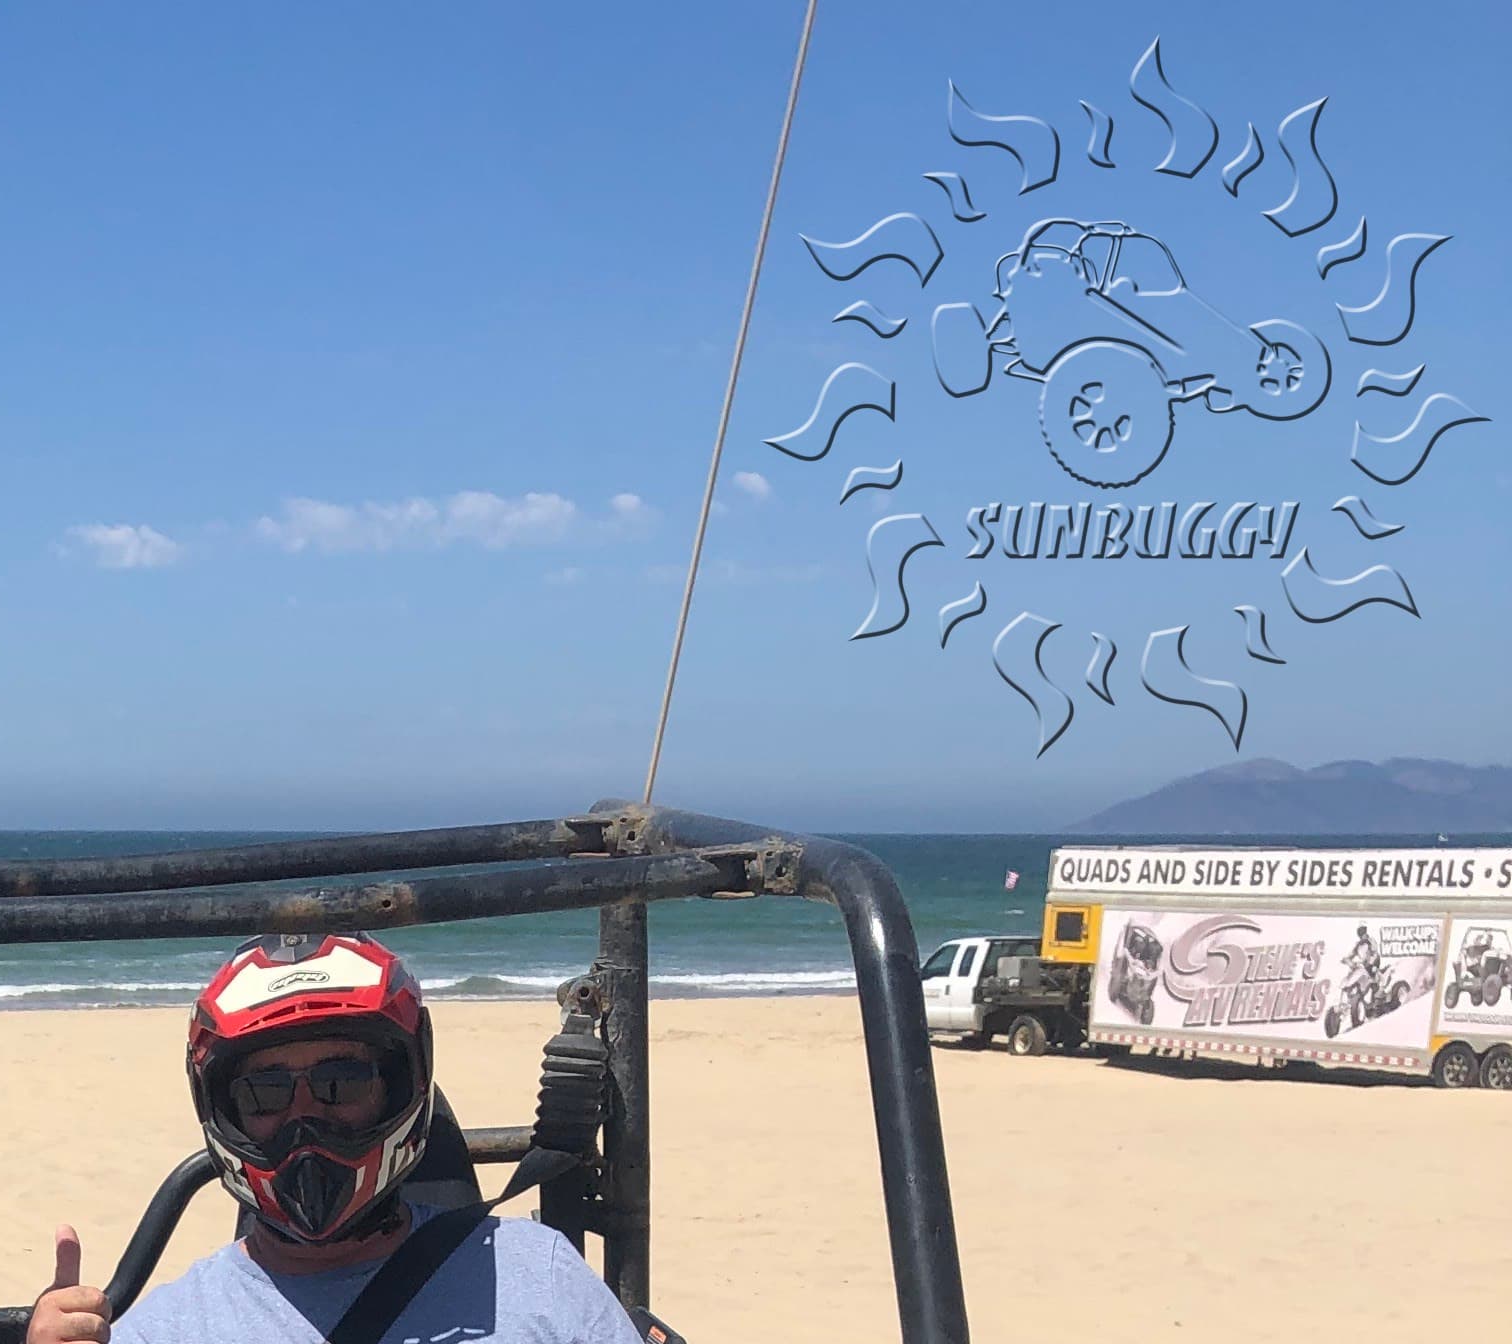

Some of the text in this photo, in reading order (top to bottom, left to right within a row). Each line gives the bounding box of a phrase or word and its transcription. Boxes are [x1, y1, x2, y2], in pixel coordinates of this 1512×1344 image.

[1060, 857, 1131, 884] QUADS
[1136, 859, 1186, 885] AND
[1192, 859, 1244, 886] SIDE
[1249, 860, 1281, 887] BY
[1285, 859, 1354, 887] SIDES
[1361, 859, 1475, 888] RENTALS
[1380, 941, 1438, 958] WELCOME
[1227, 978, 1331, 1025] RENTALS
